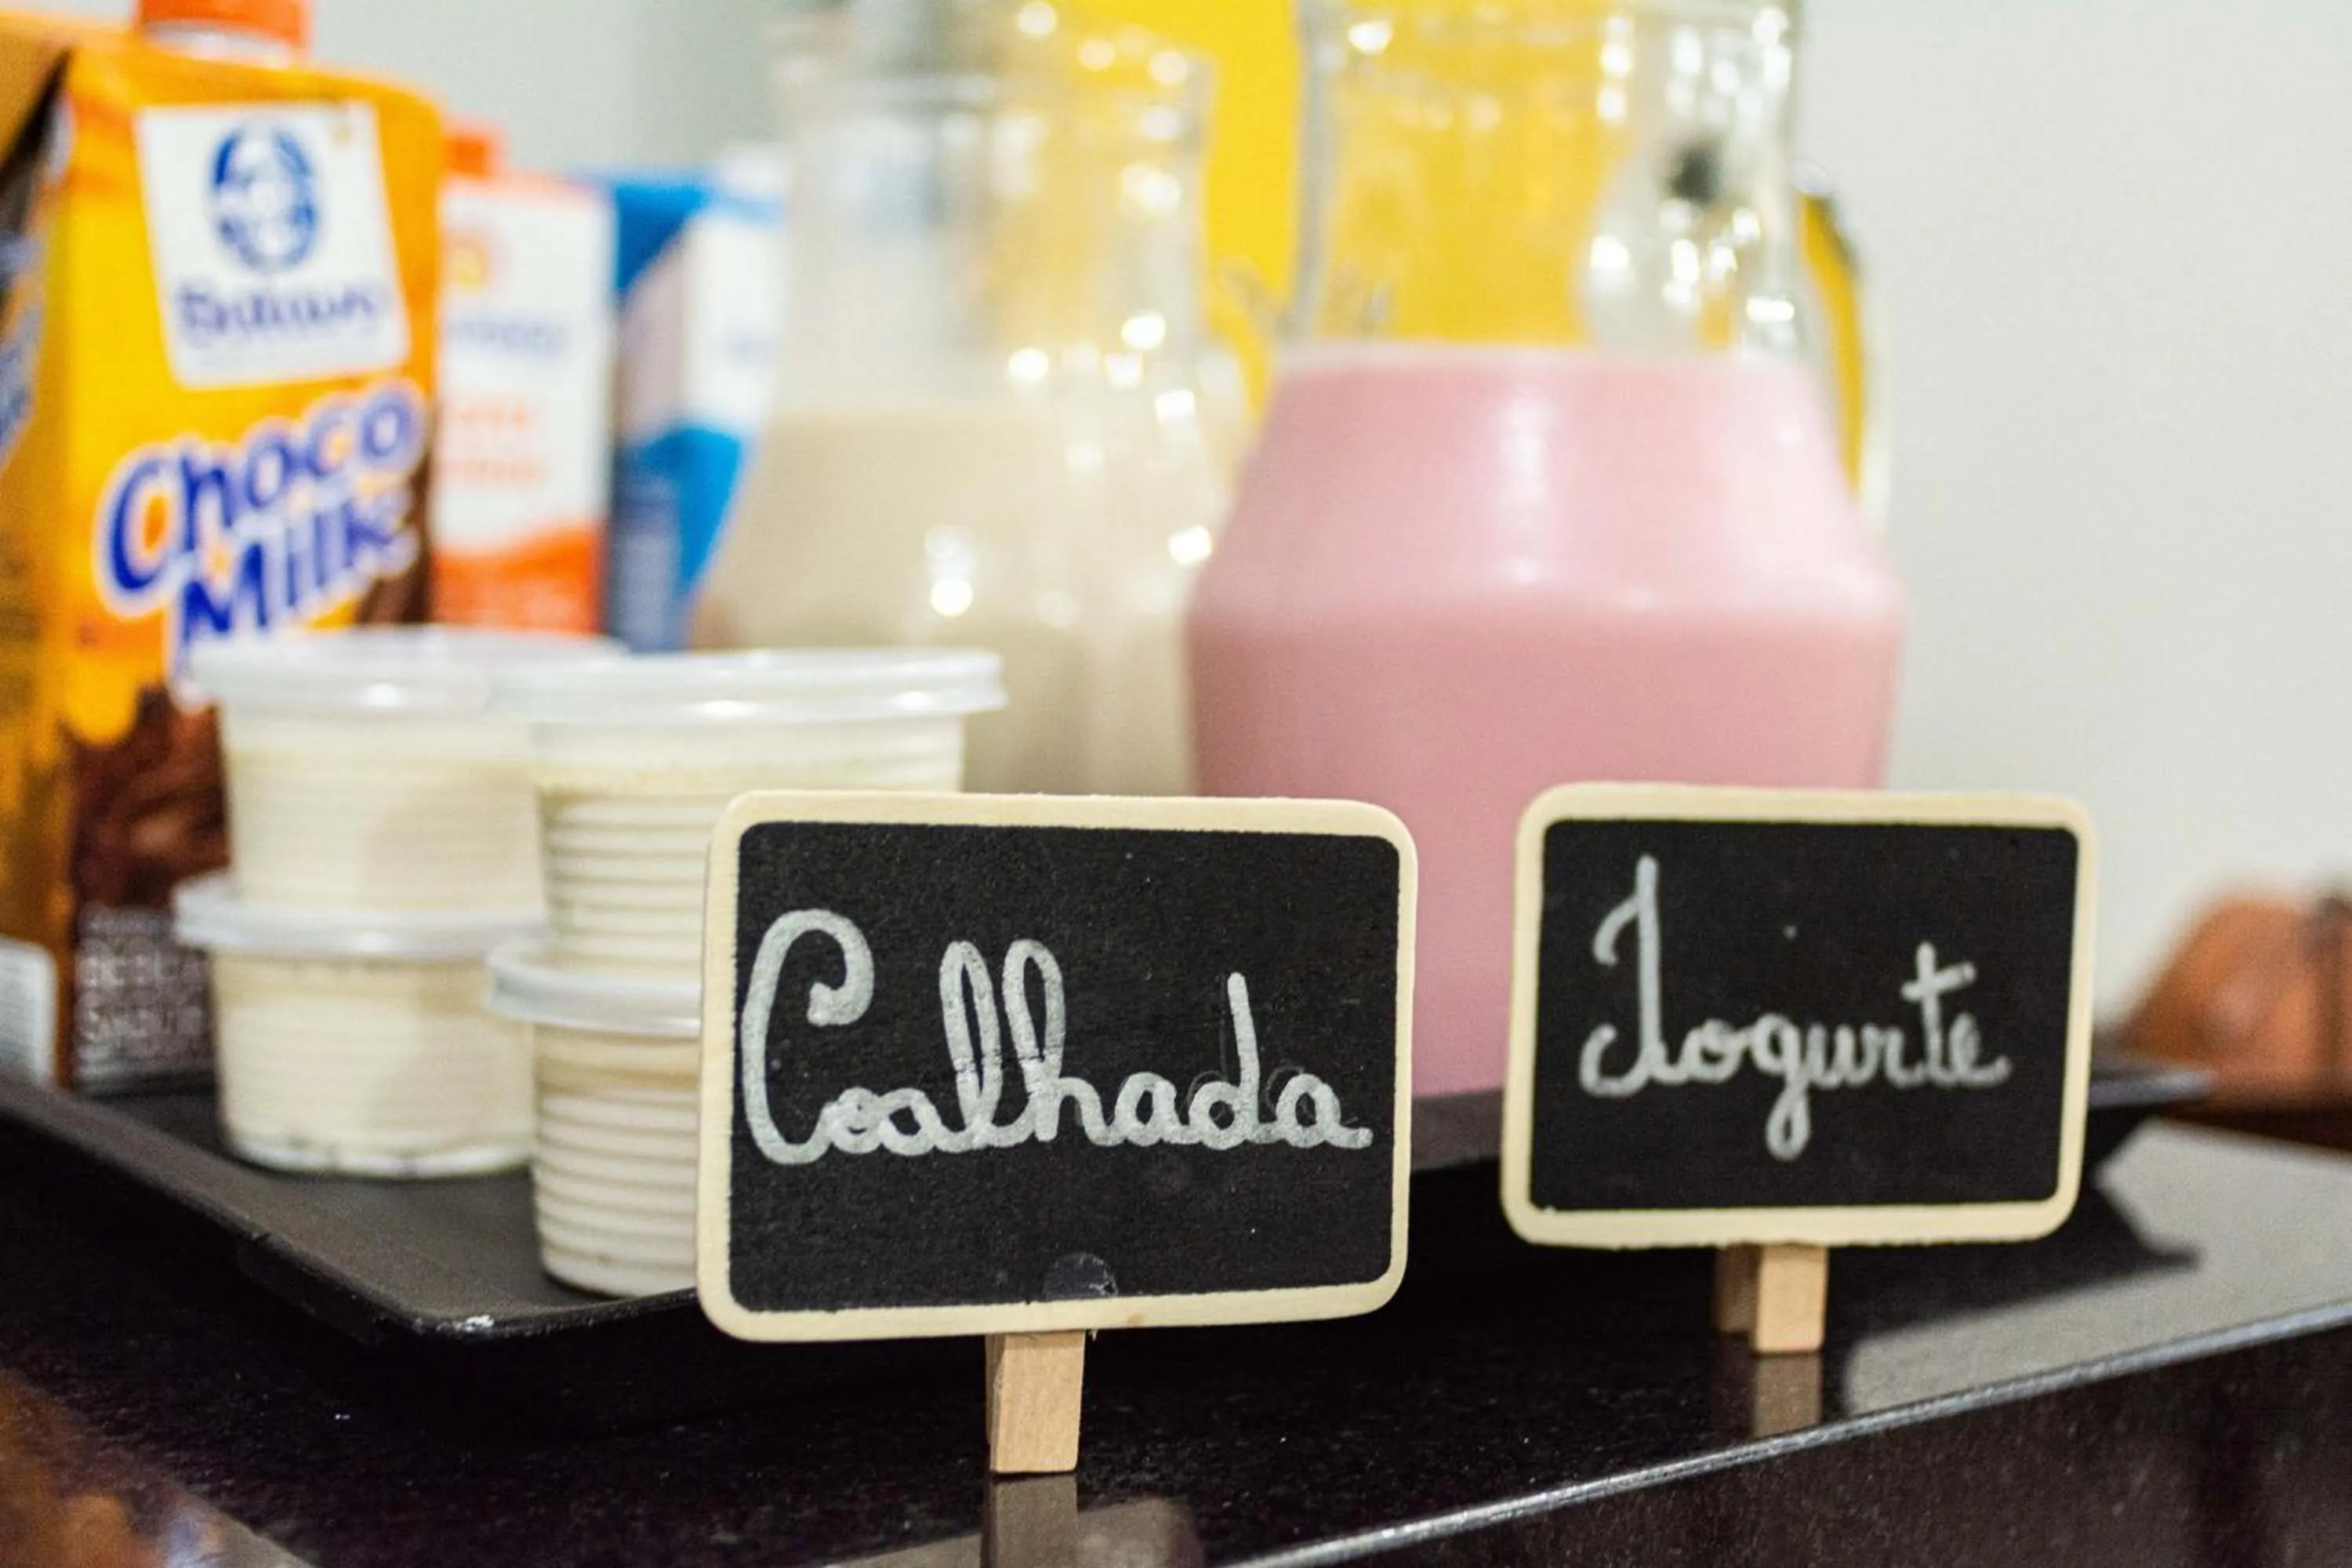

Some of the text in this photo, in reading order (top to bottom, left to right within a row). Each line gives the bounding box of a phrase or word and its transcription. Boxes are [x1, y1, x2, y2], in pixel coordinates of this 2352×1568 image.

[105, 392, 417, 597] Choco
[174, 488, 401, 660] Milk
[741, 908, 1374, 1166] Coalhada
[1579, 854, 2013, 1161] Iogurte
